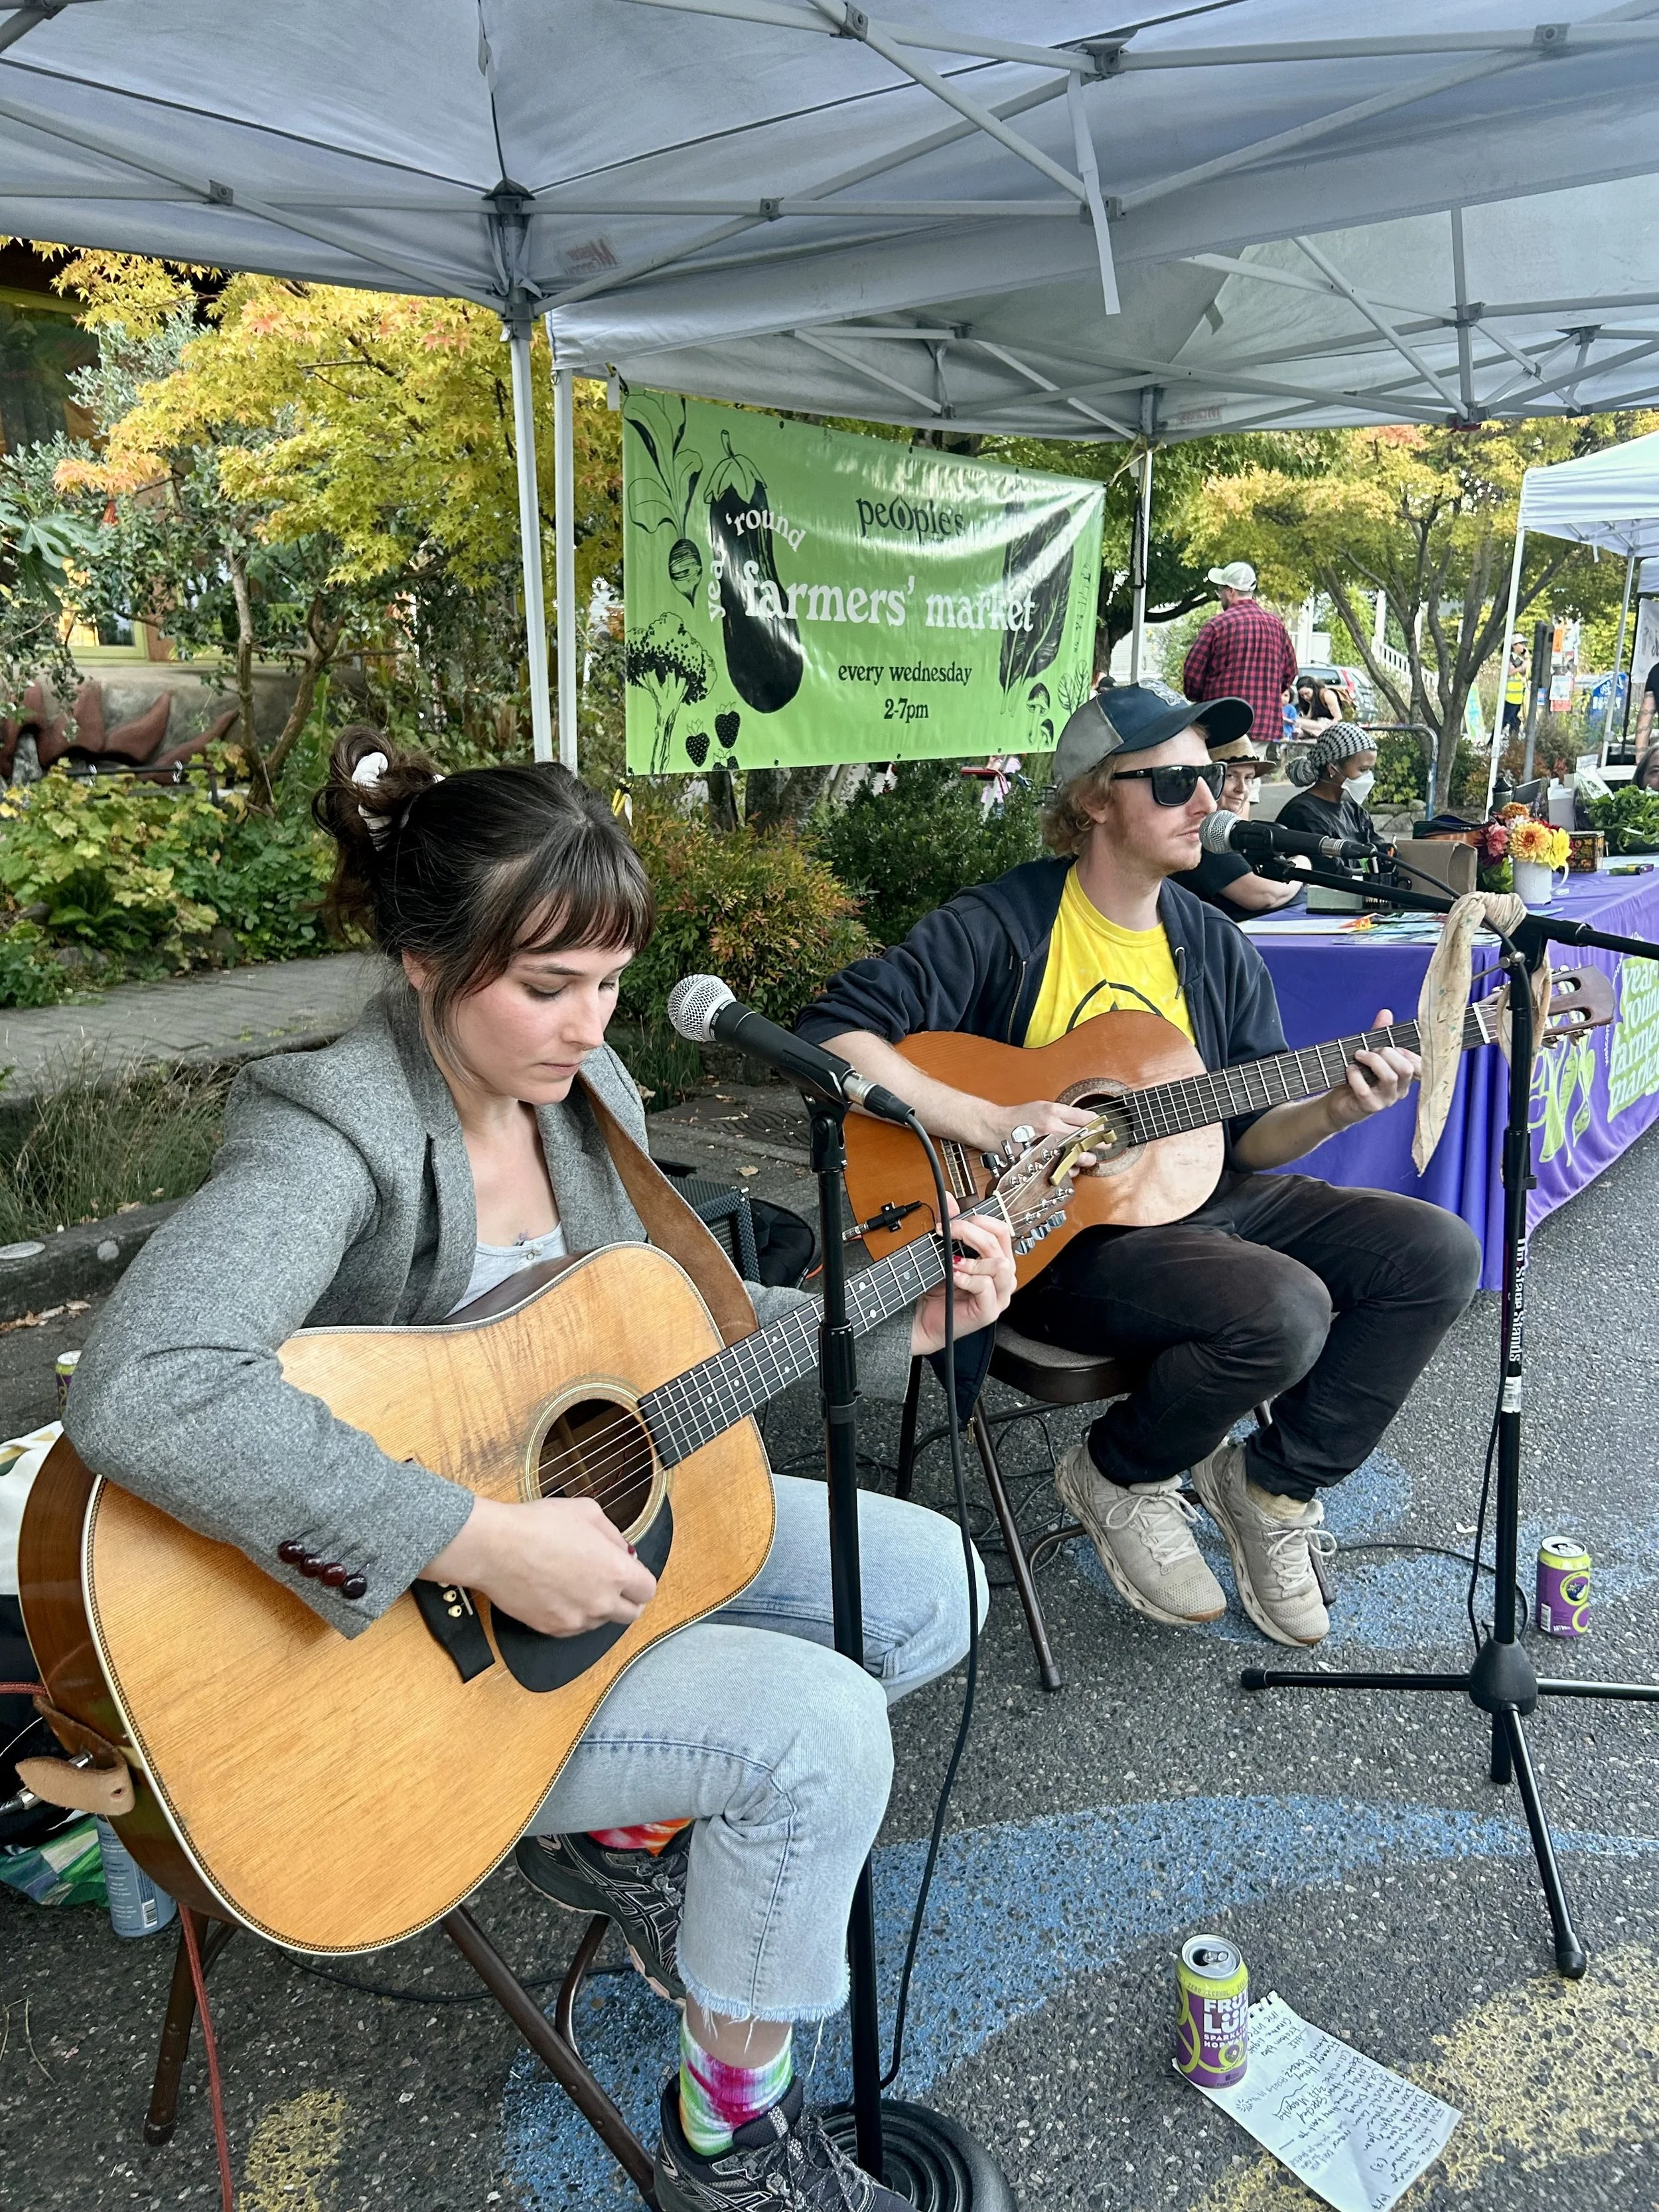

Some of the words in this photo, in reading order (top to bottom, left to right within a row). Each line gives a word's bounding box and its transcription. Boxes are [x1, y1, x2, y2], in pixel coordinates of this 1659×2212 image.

[707, 546, 727, 623] yea
[743, 559, 915, 627] farmers'
[926, 591, 1036, 632] market
[838, 664, 885, 686] every
[889, 661, 973, 686] wednesday
[883, 698, 929, 723] 2-7pm
